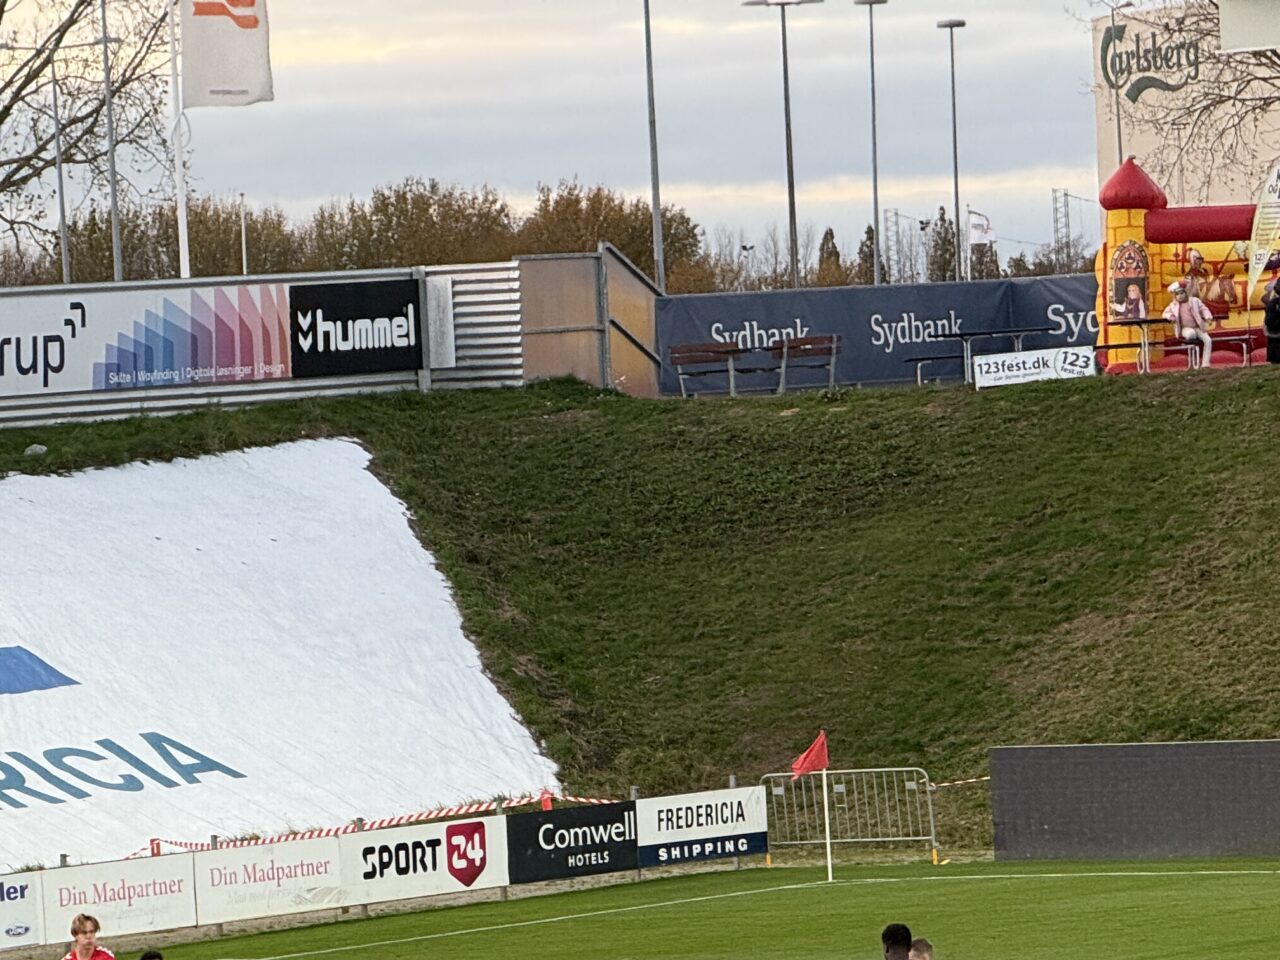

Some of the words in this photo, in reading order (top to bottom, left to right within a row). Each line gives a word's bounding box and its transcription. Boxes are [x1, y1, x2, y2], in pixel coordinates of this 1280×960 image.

[1101, 24, 1200, 103] Carlsberg
[316, 303, 416, 352] hummel
[870, 310, 963, 352] Sydbank
[977, 356, 1051, 375] 123fest.dk
[1061, 350, 1092, 369] 123
[538, 811, 637, 850] Comwell
[657, 800, 746, 832] FREDERICIA
[362, 838, 442, 881] SPORT
[449, 832, 484, 871] 24
[568, 850, 610, 868] HOTELS
[658, 838, 749, 862] SHIPPING
[209, 865, 238, 887] Din
[242, 858, 331, 887] Madpartner
[57, 886, 90, 908] Din
[92, 877, 184, 907] Madpartner
